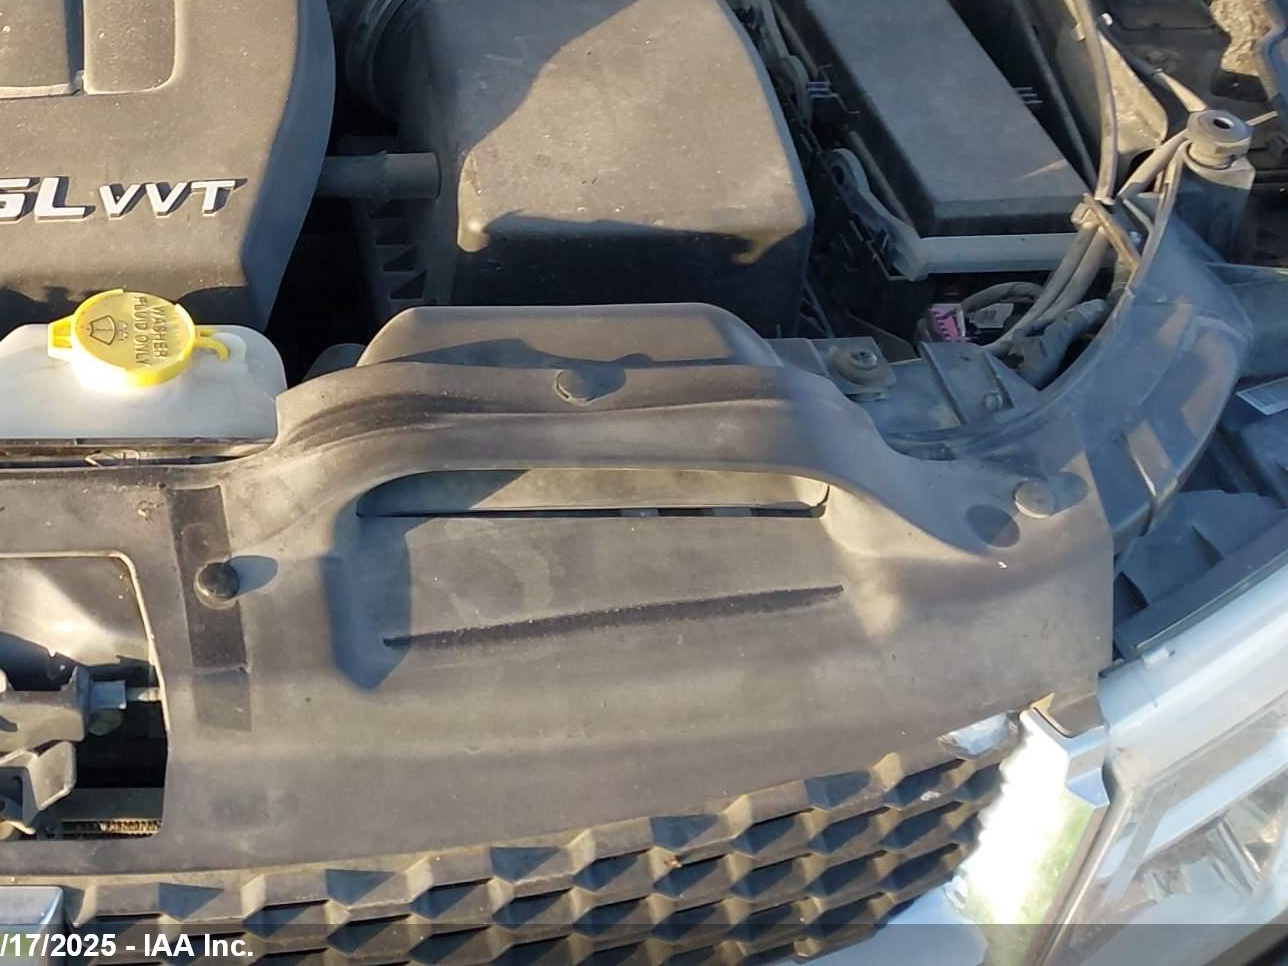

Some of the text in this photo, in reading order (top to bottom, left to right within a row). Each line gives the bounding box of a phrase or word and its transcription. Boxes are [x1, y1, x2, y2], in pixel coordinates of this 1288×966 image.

[99, 179, 240, 219] VVT
[133, 296, 152, 366] FLUID ONLY
[152, 304, 170, 359] WASHER
